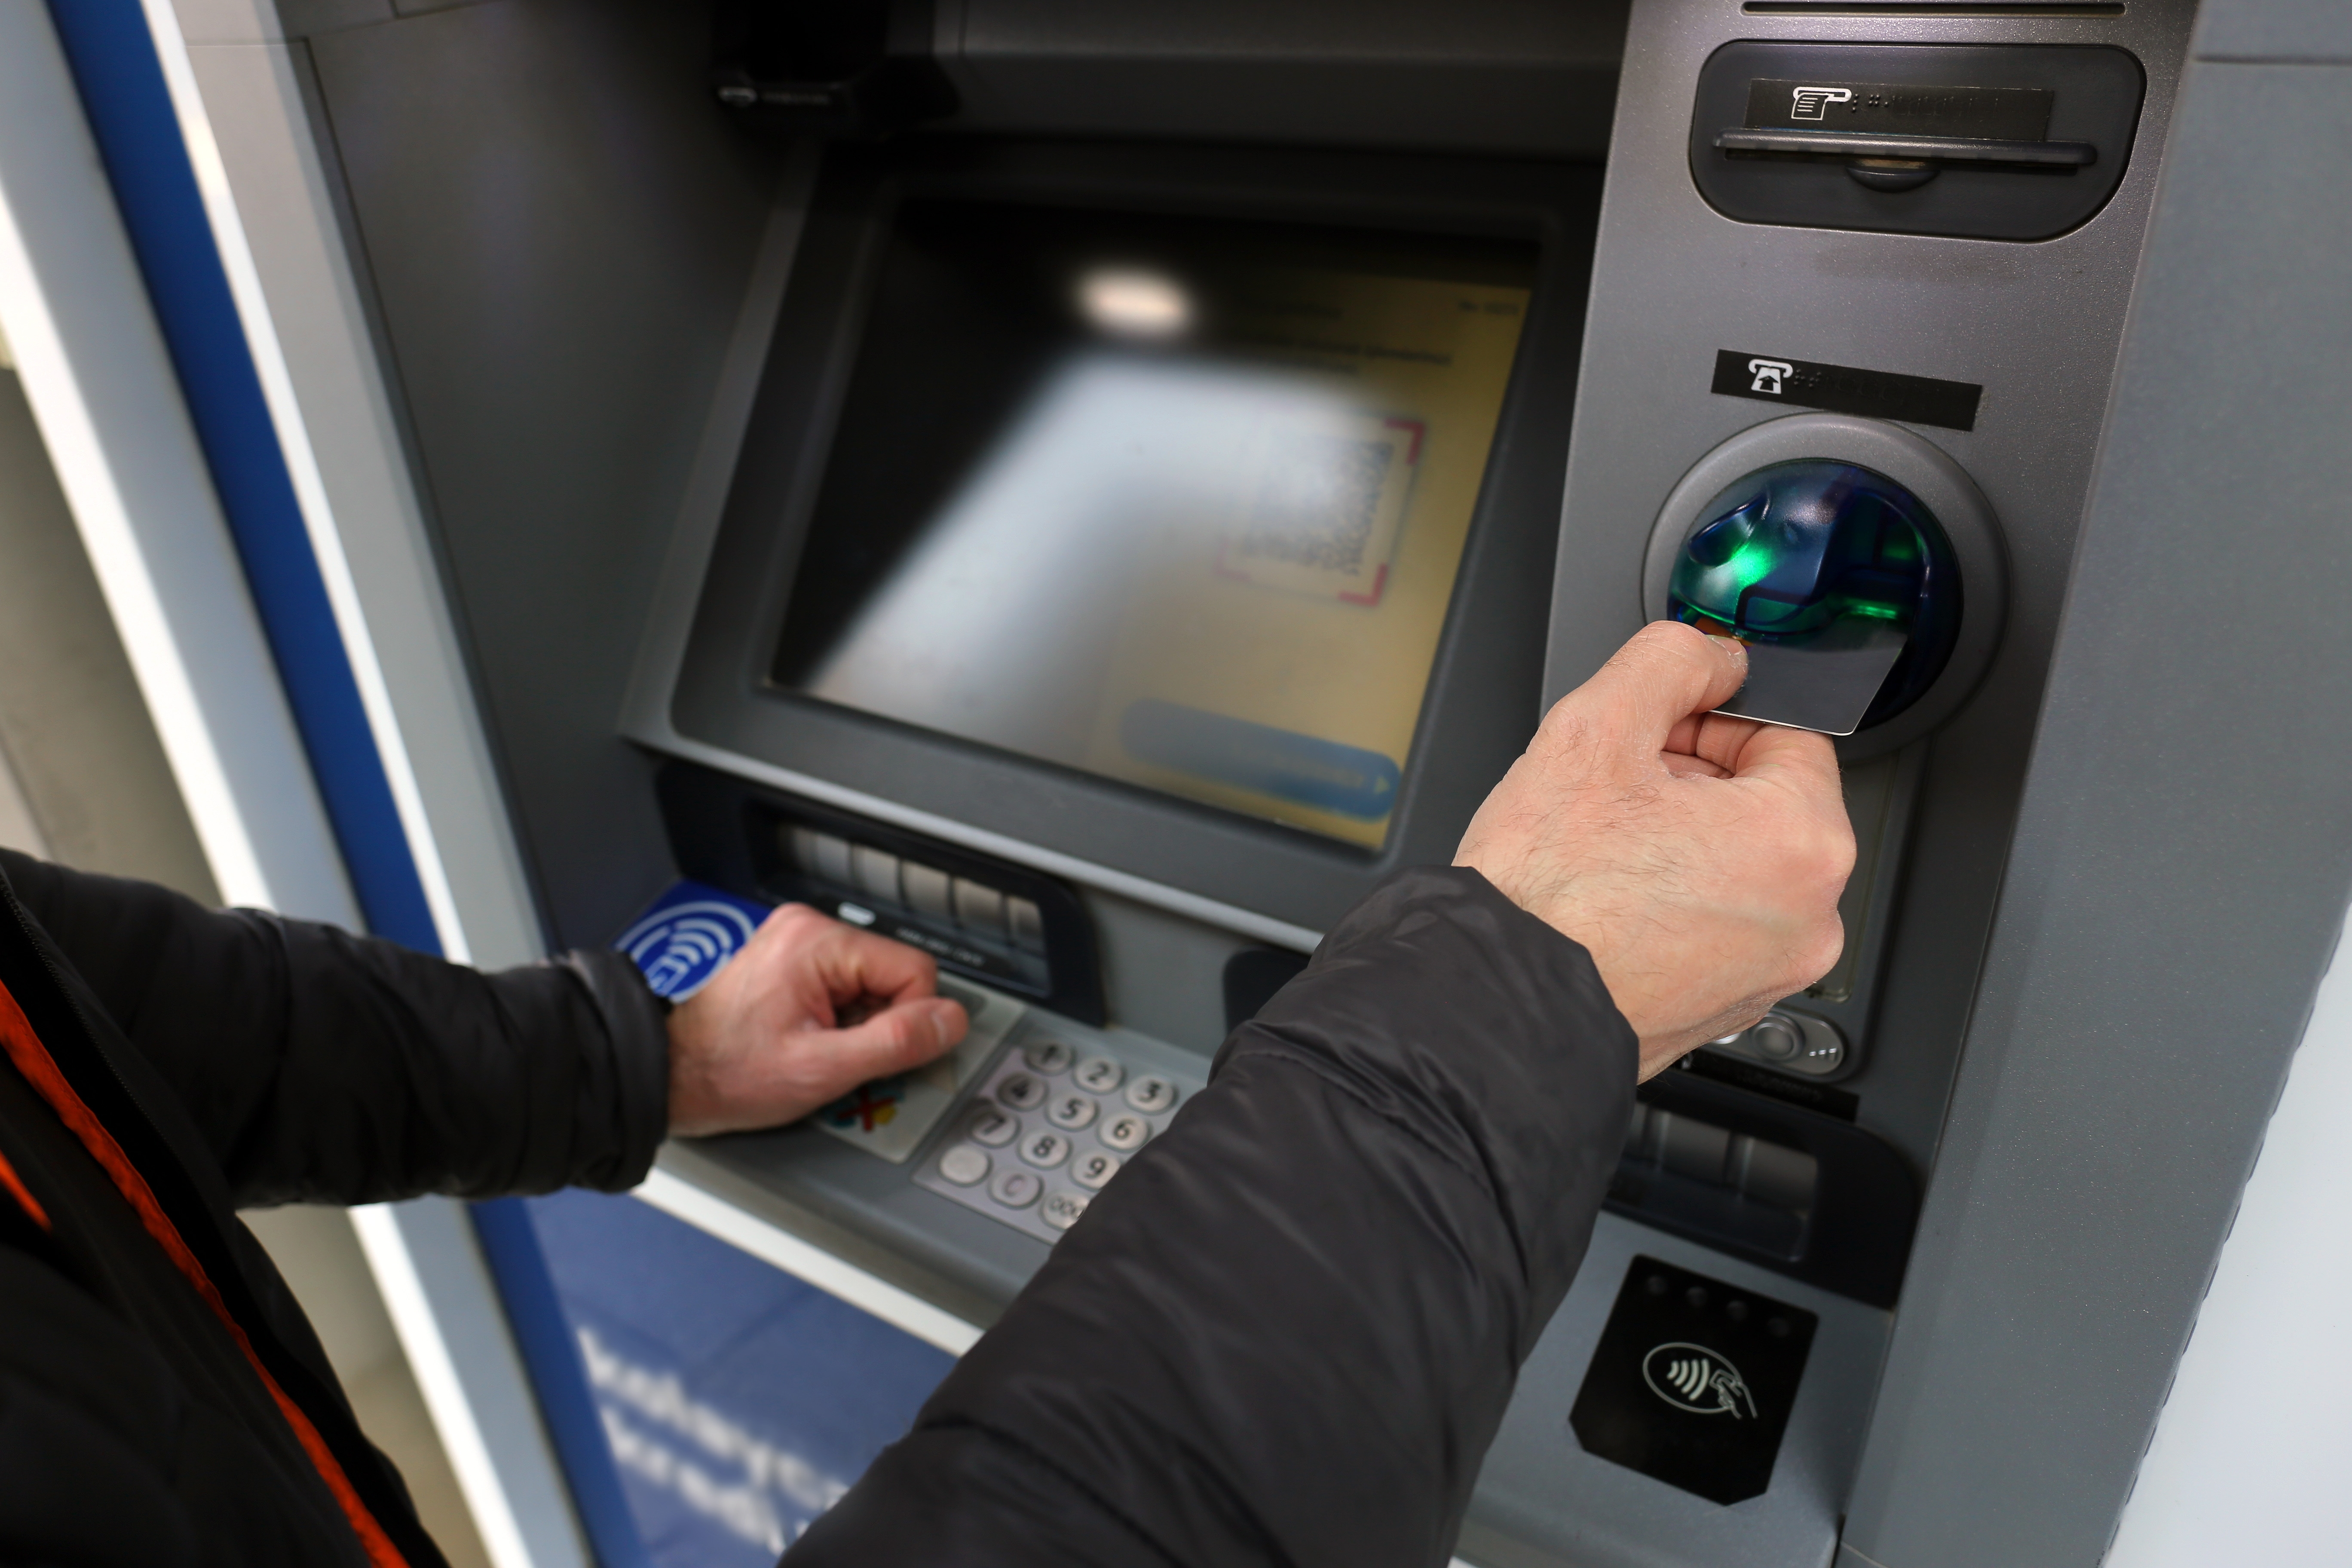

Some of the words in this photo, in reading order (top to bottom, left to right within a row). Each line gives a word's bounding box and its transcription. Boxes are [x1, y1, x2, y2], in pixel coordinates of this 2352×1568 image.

[1043, 1043, 1059, 1063] 1
[1088, 1061, 1110, 1085] 2
[1011, 1079, 1030, 1099] 4
[1138, 1080, 1160, 1103] 3
[1060, 1098, 1081, 1120] 5
[984, 1116, 1008, 1135] 7
[1114, 1118, 1134, 1140] 6
[1033, 1134, 1056, 1158] 8
[1084, 1156, 1107, 1180] 9
